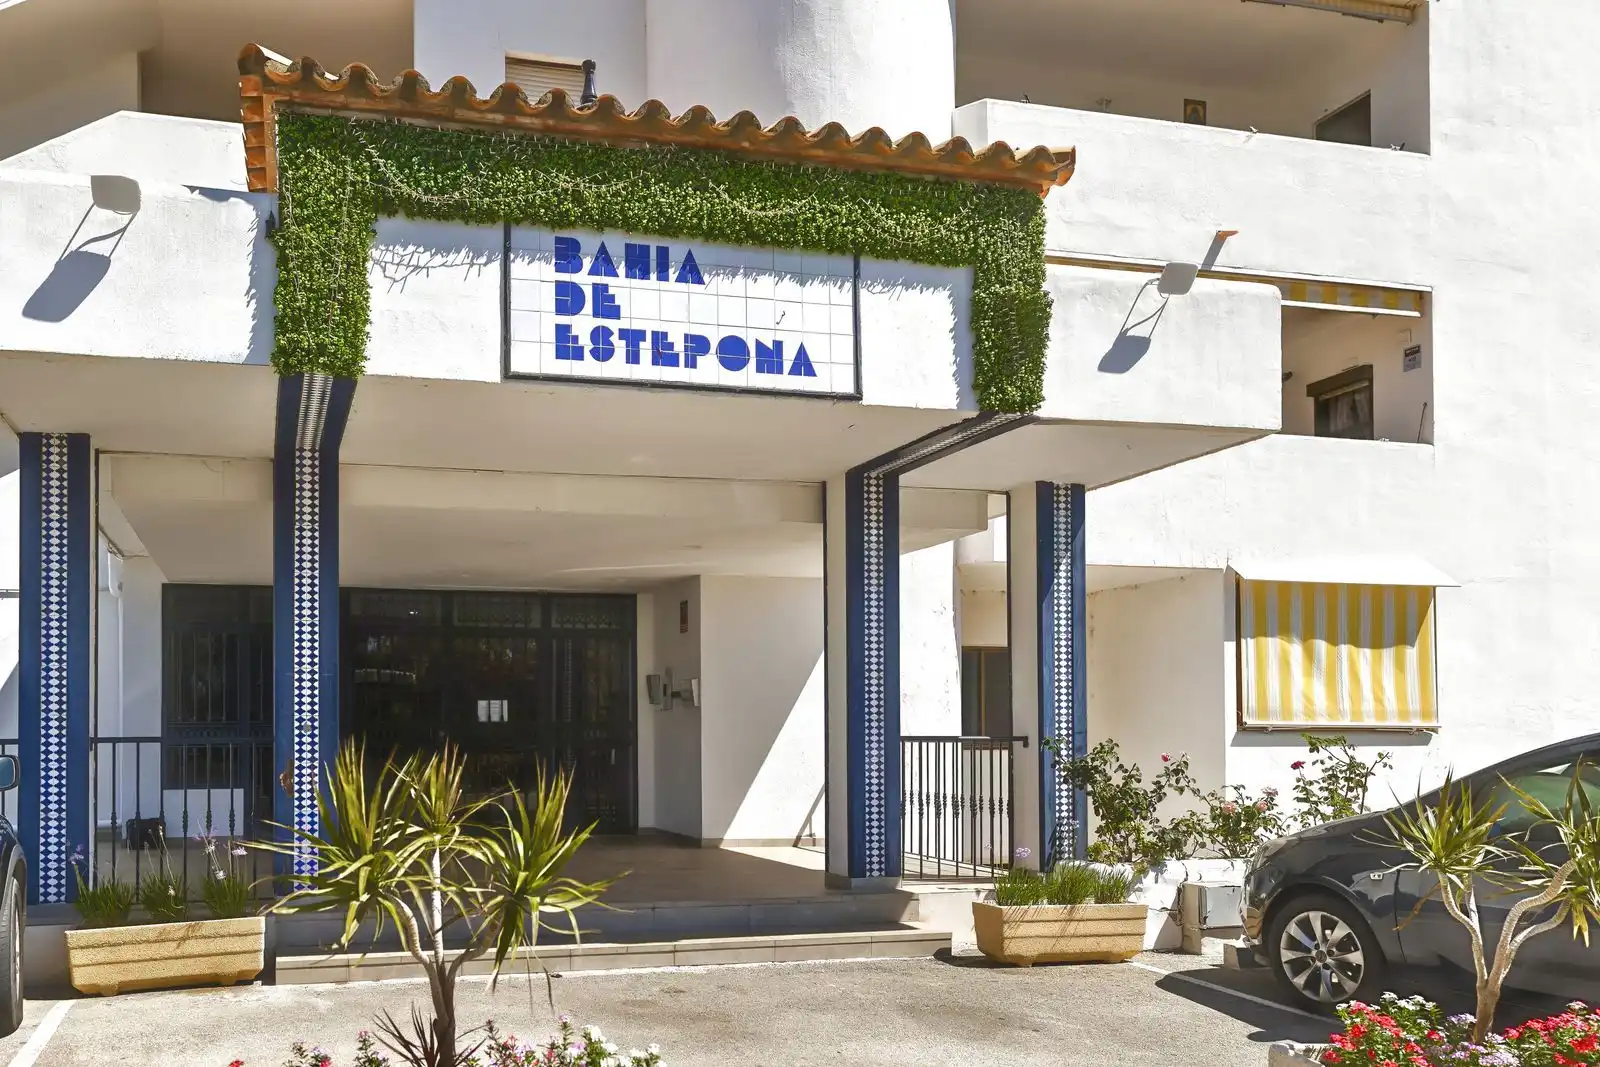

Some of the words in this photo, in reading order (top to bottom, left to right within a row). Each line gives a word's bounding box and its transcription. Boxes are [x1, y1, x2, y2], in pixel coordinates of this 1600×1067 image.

[555, 236, 705, 285] BAHIA
[555, 281, 621, 320] DE
[555, 324, 817, 377] ESTEPONA
